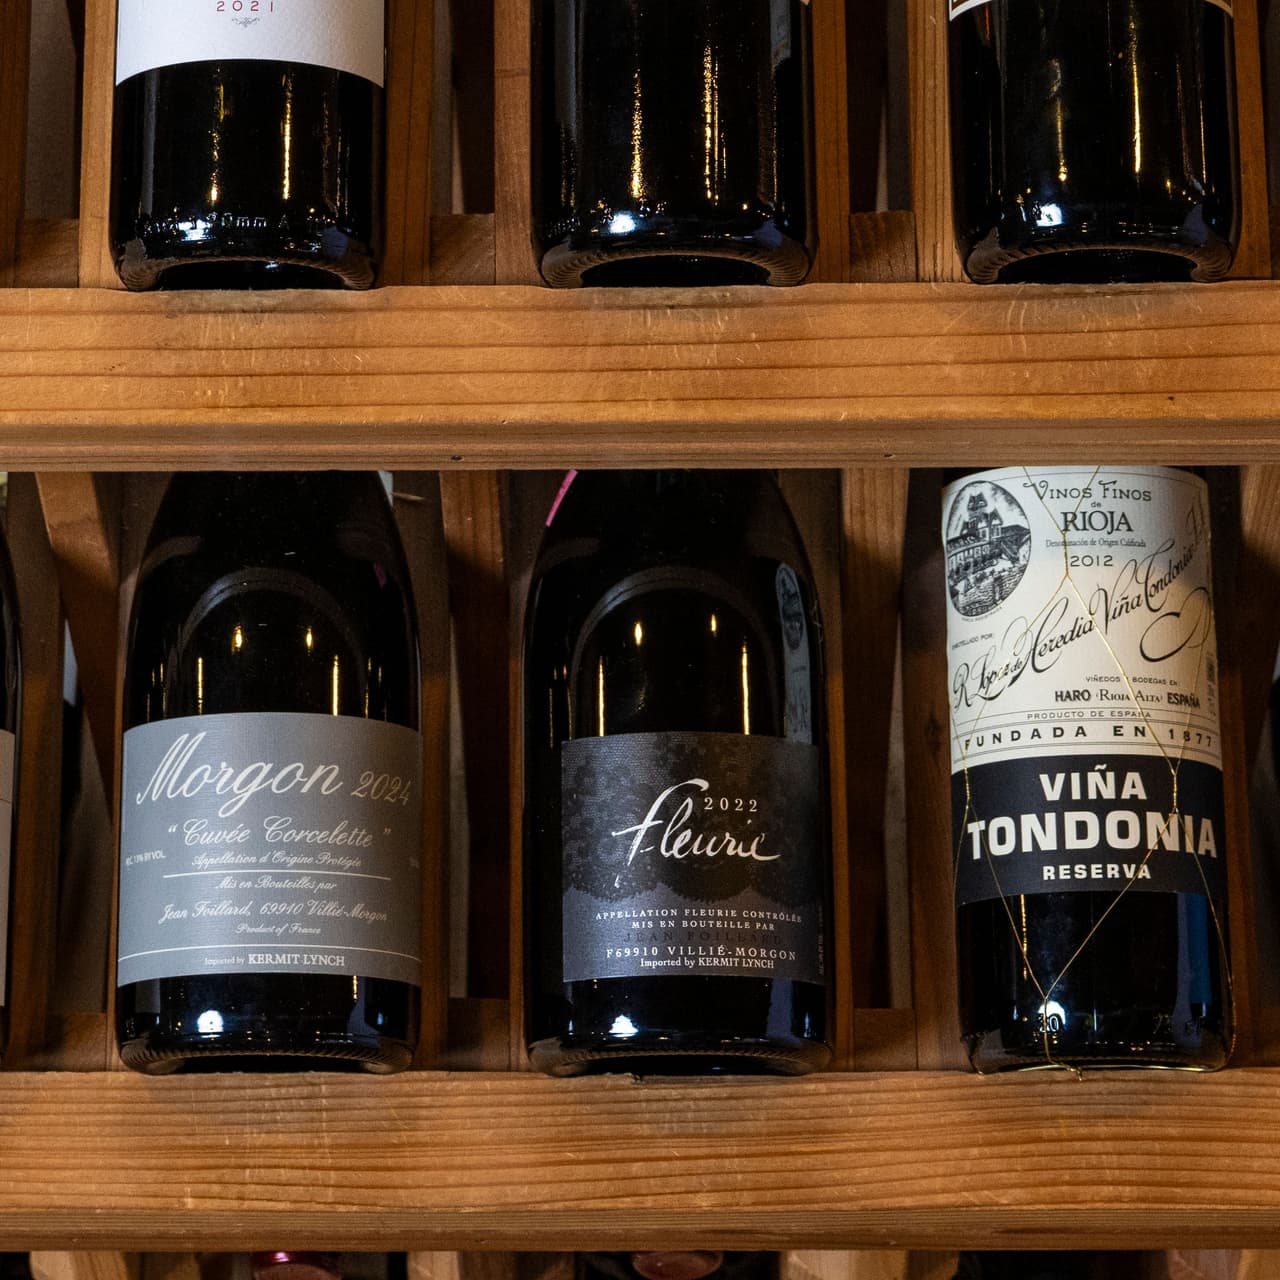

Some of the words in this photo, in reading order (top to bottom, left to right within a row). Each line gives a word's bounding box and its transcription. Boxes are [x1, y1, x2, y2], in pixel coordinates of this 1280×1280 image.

[216, 0, 274, 13] 2021
[1061, 510, 1134, 535] RIOJA
[1069, 555, 1114, 568] 2012
[964, 725, 1088, 752] FUNDADA
[1112, 725, 1147, 739] EN
[1168, 727, 1213, 748] 1877
[136, 732, 344, 818] Morgon
[350, 770, 409, 806] 2024
[1039, 763, 1147, 802] VIÑA
[704, 796, 758, 812] 2022
[967, 810, 1219, 861] TONDONIA
[1042, 863, 1152, 882] RESERVA
[640, 958, 681, 969] Imported
[684, 959, 695, 968] by
[698, 958, 740, 968] KERMIT
[742, 959, 775, 969] LYNCH
